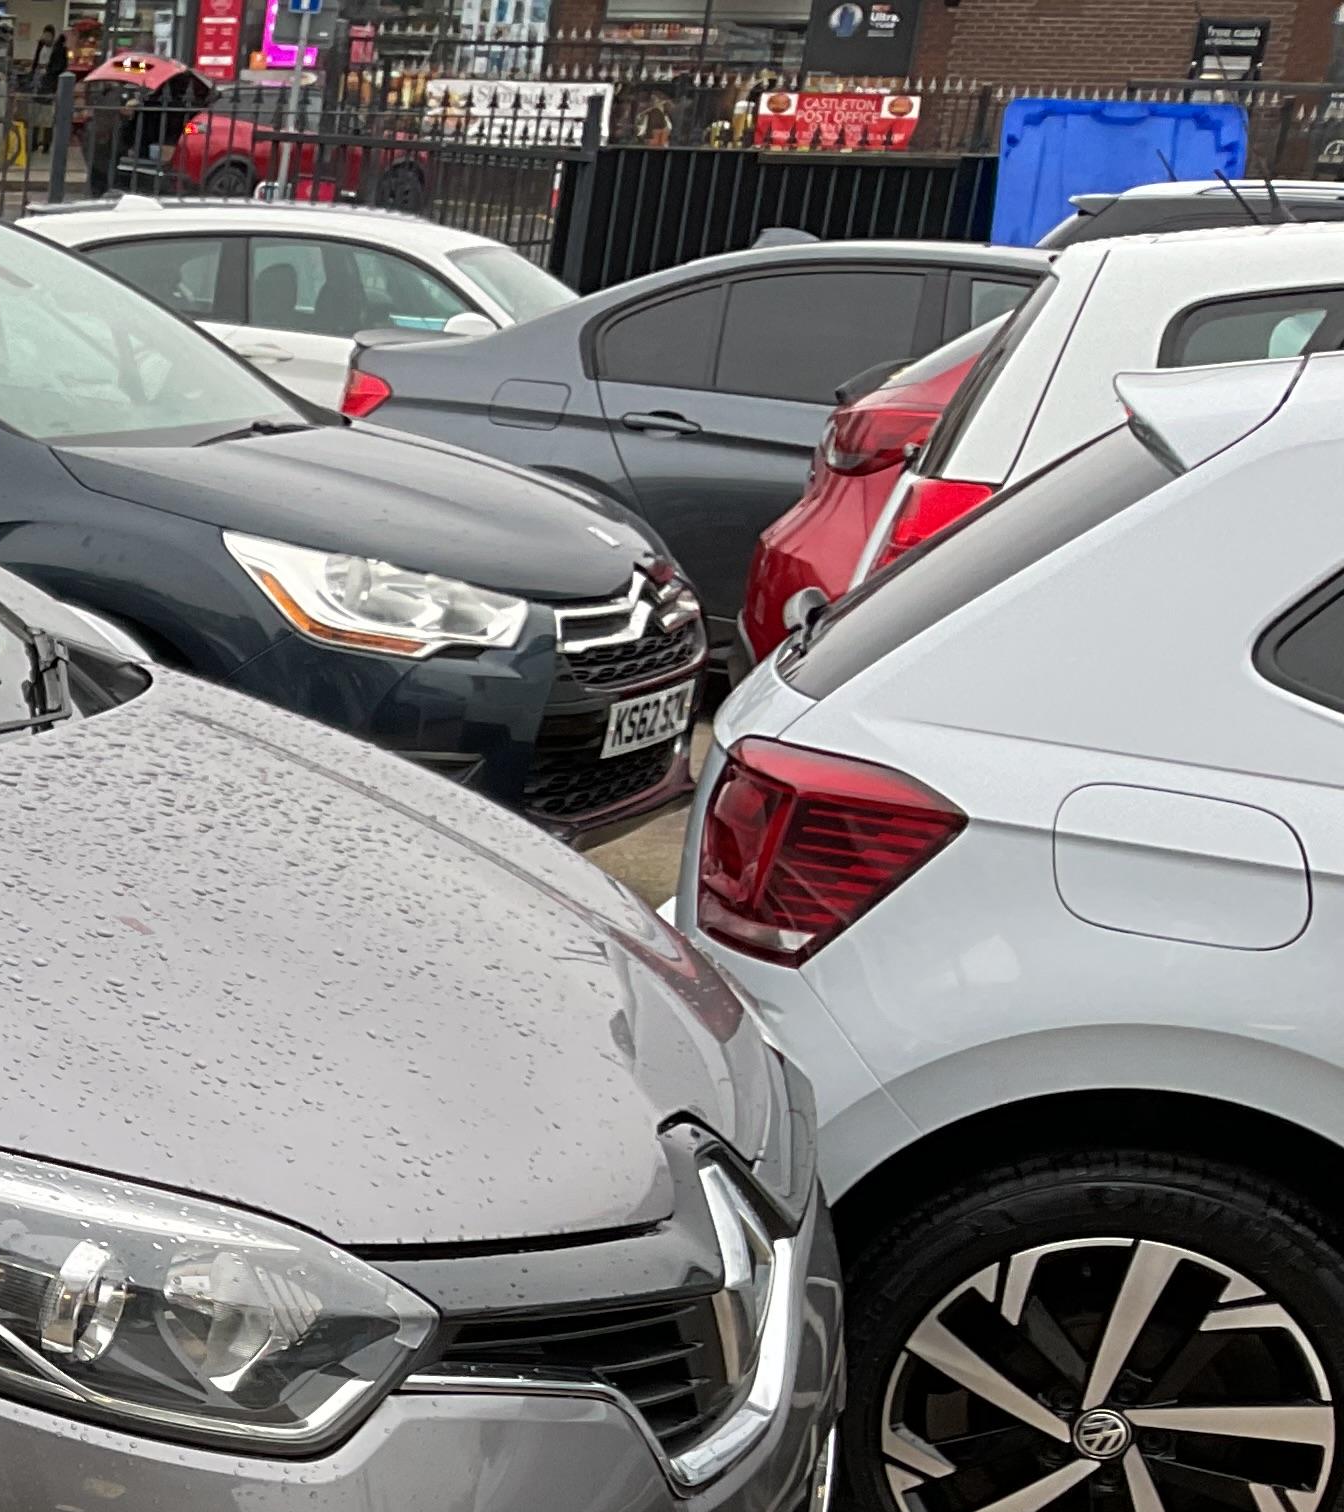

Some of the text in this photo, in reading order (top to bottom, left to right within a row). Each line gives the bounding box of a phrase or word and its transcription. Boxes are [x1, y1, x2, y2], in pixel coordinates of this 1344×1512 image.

[803, 97, 877, 111] CASTLETON
[796, 109, 881, 124] POST OFFICE
